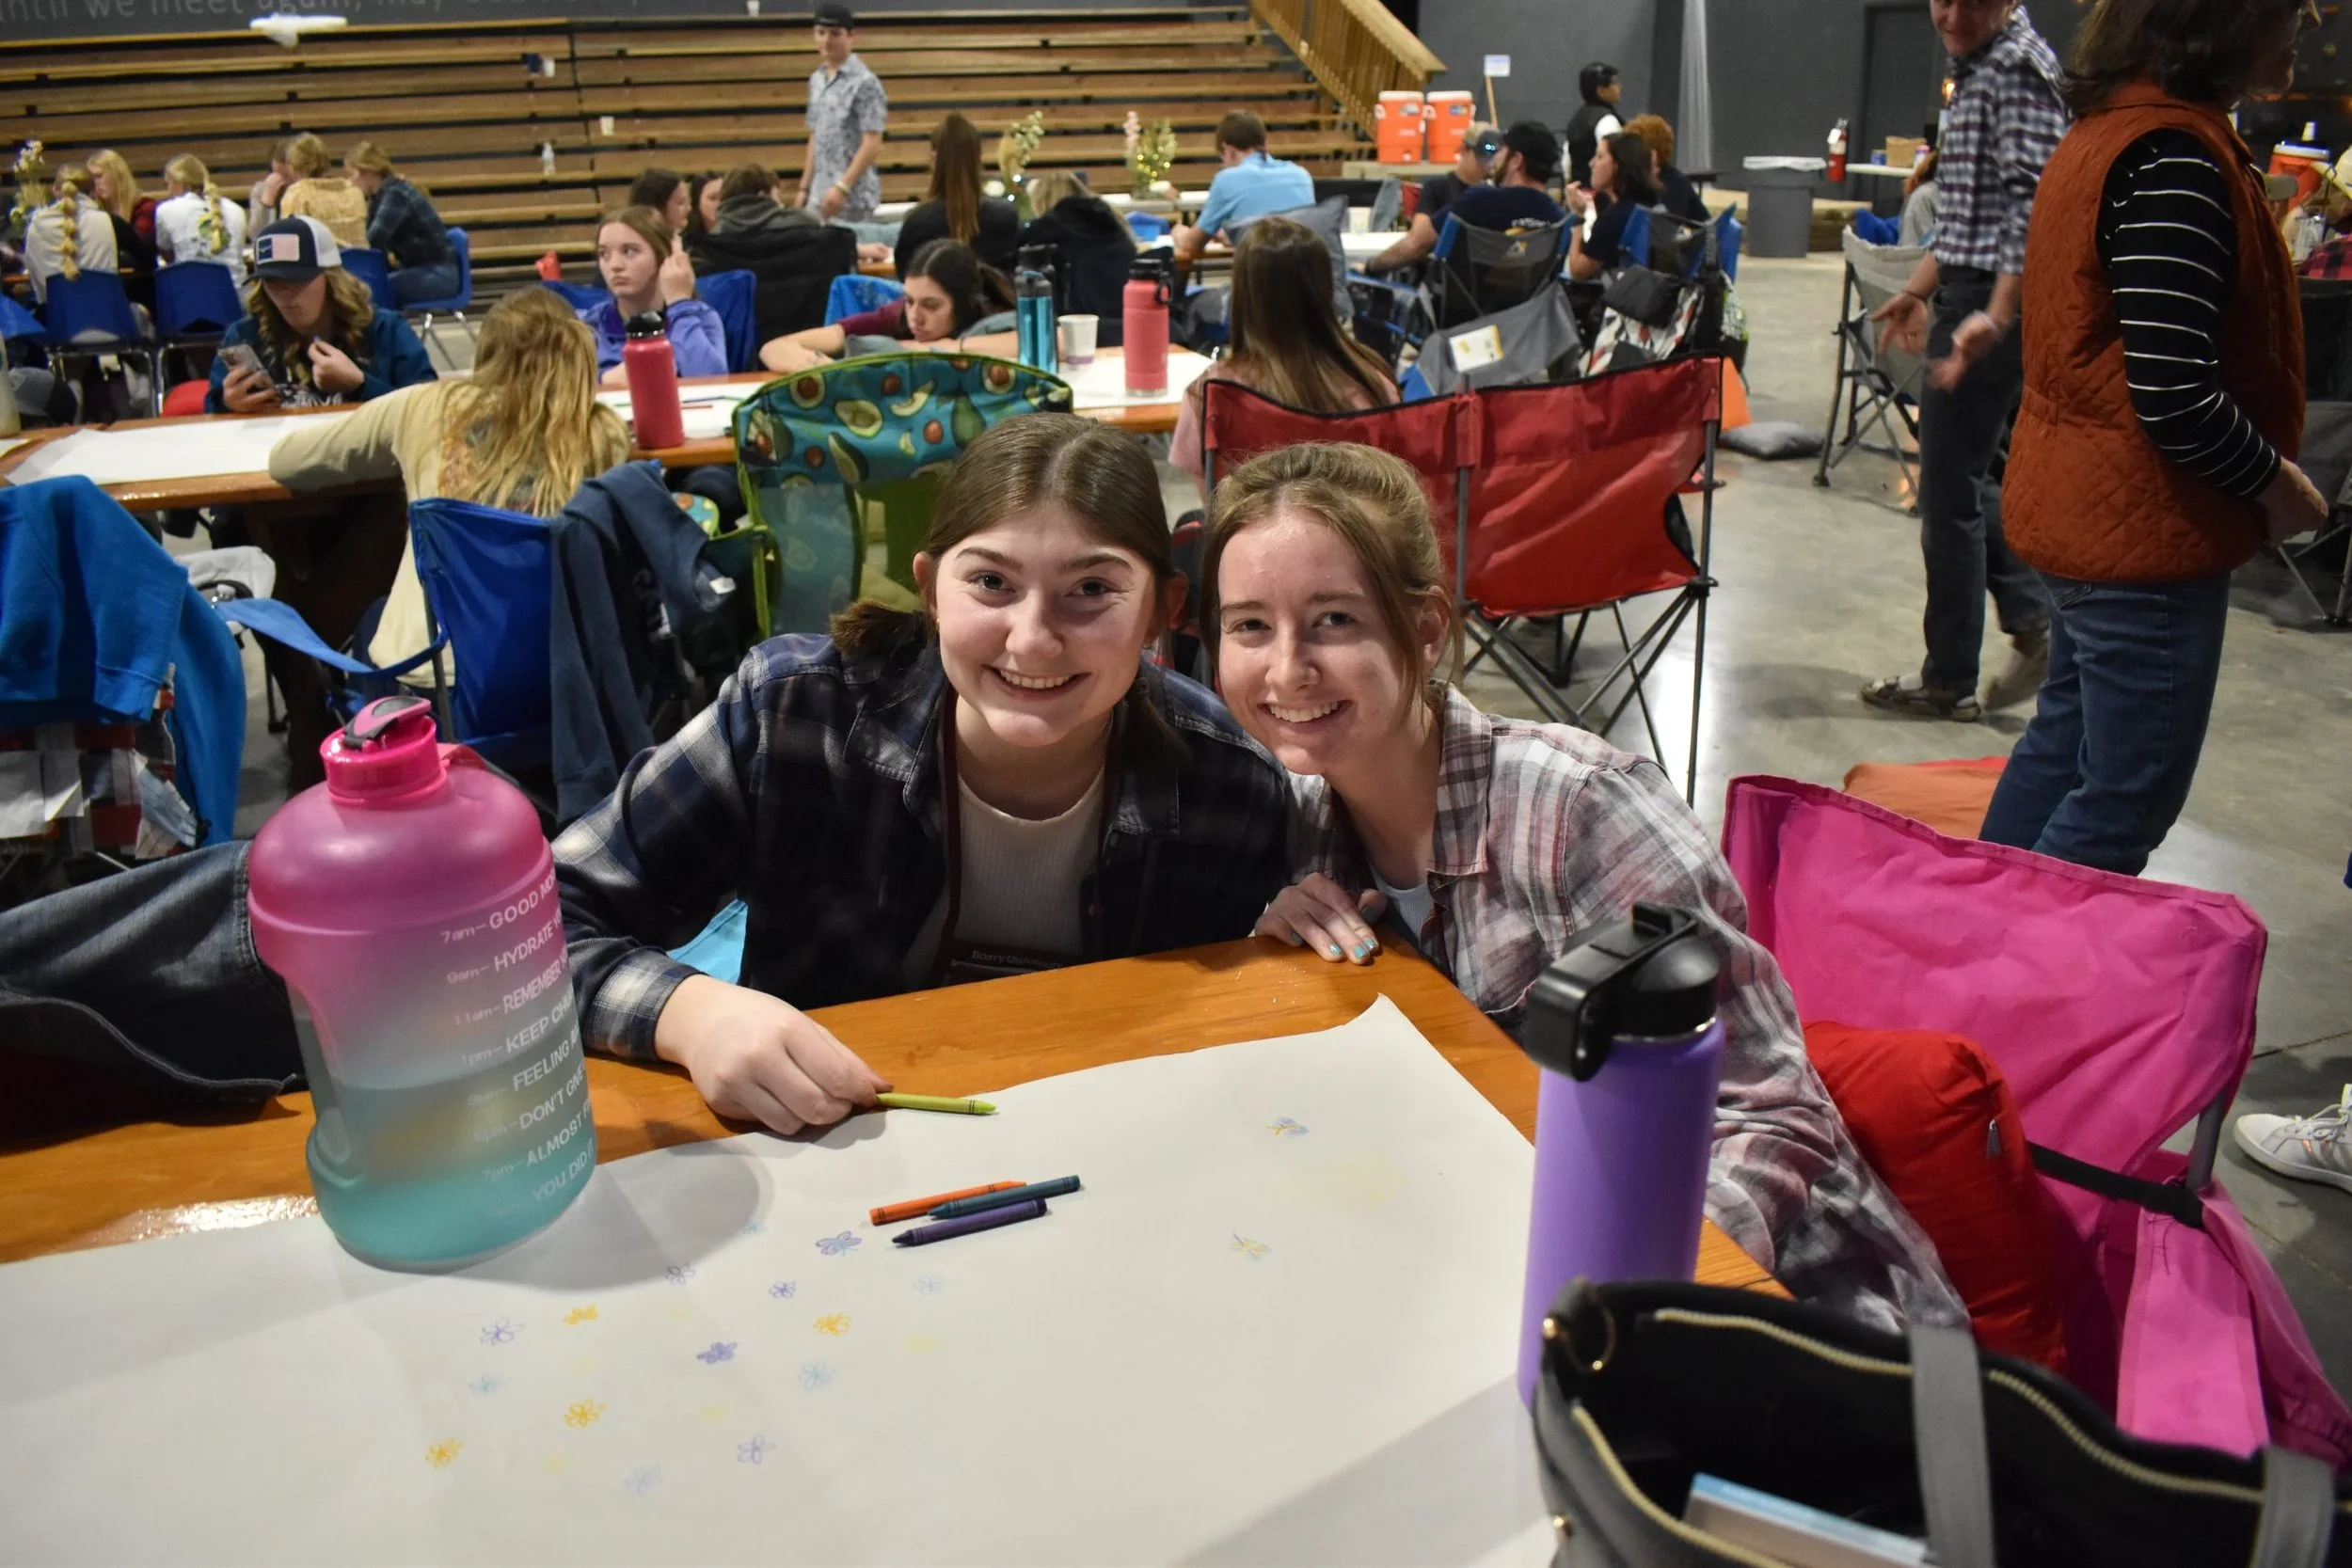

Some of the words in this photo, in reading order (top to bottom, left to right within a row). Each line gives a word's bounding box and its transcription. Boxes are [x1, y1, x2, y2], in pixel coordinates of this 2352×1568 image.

[488, 890, 539, 930] GOOD
[493, 919, 554, 973] HYDRATE
[502, 958, 562, 1015] REMEMBER
[505, 1015, 548, 1054] KEEP
[512, 1038, 570, 1092] FEELING
[518, 1087, 564, 1131] DON'T
[526, 1110, 583, 1169] ALMOST
[531, 1170, 566, 1202] YOU
[567, 1150, 588, 1180] DID
